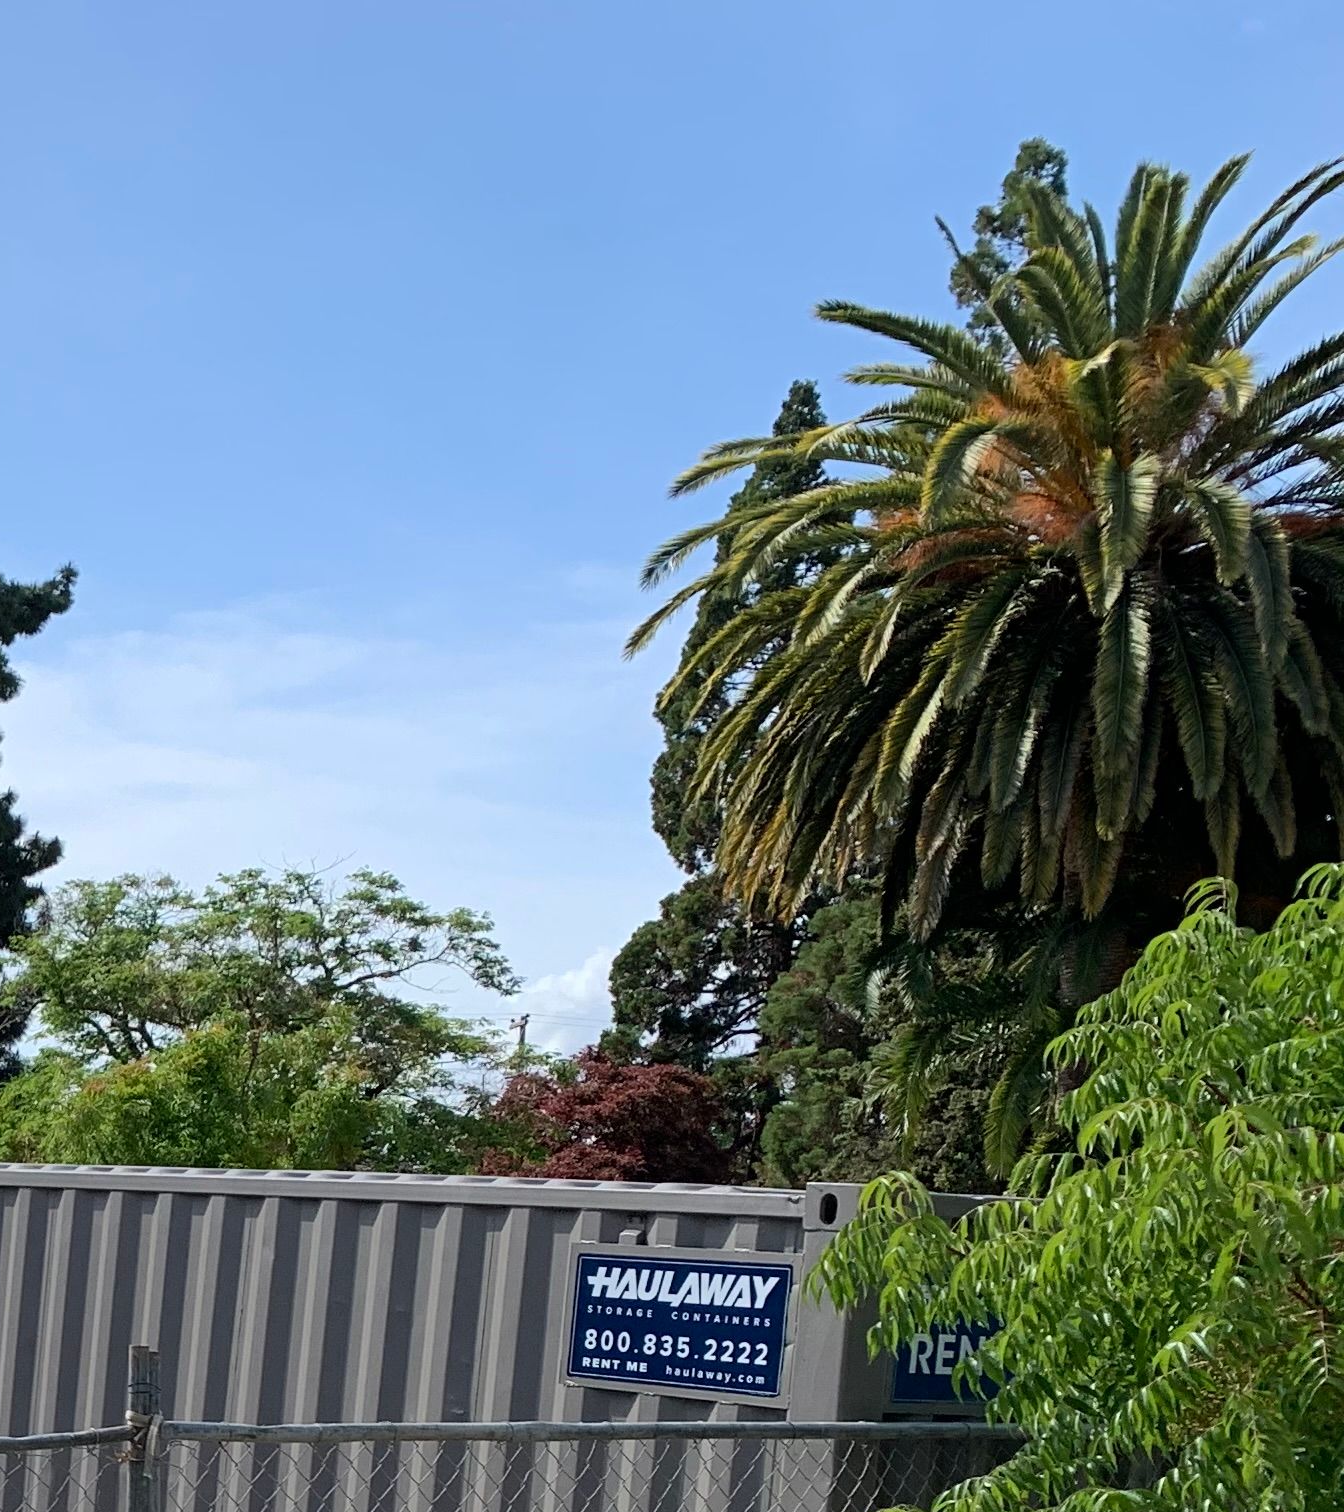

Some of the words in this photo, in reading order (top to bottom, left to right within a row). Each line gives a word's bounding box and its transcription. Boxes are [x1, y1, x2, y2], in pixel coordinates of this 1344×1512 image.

[587, 1266, 781, 1309] HAULAWAY
[587, 1304, 654, 1318] STORAGE
[671, 1311, 771, 1327] CONTAINERS
[584, 1328, 768, 1366] 800.835.2222
[908, 1332, 987, 1377] REN
[582, 1356, 620, 1370] RENT
[626, 1361, 648, 1373] ME
[665, 1364, 765, 1385] haulaway.com
